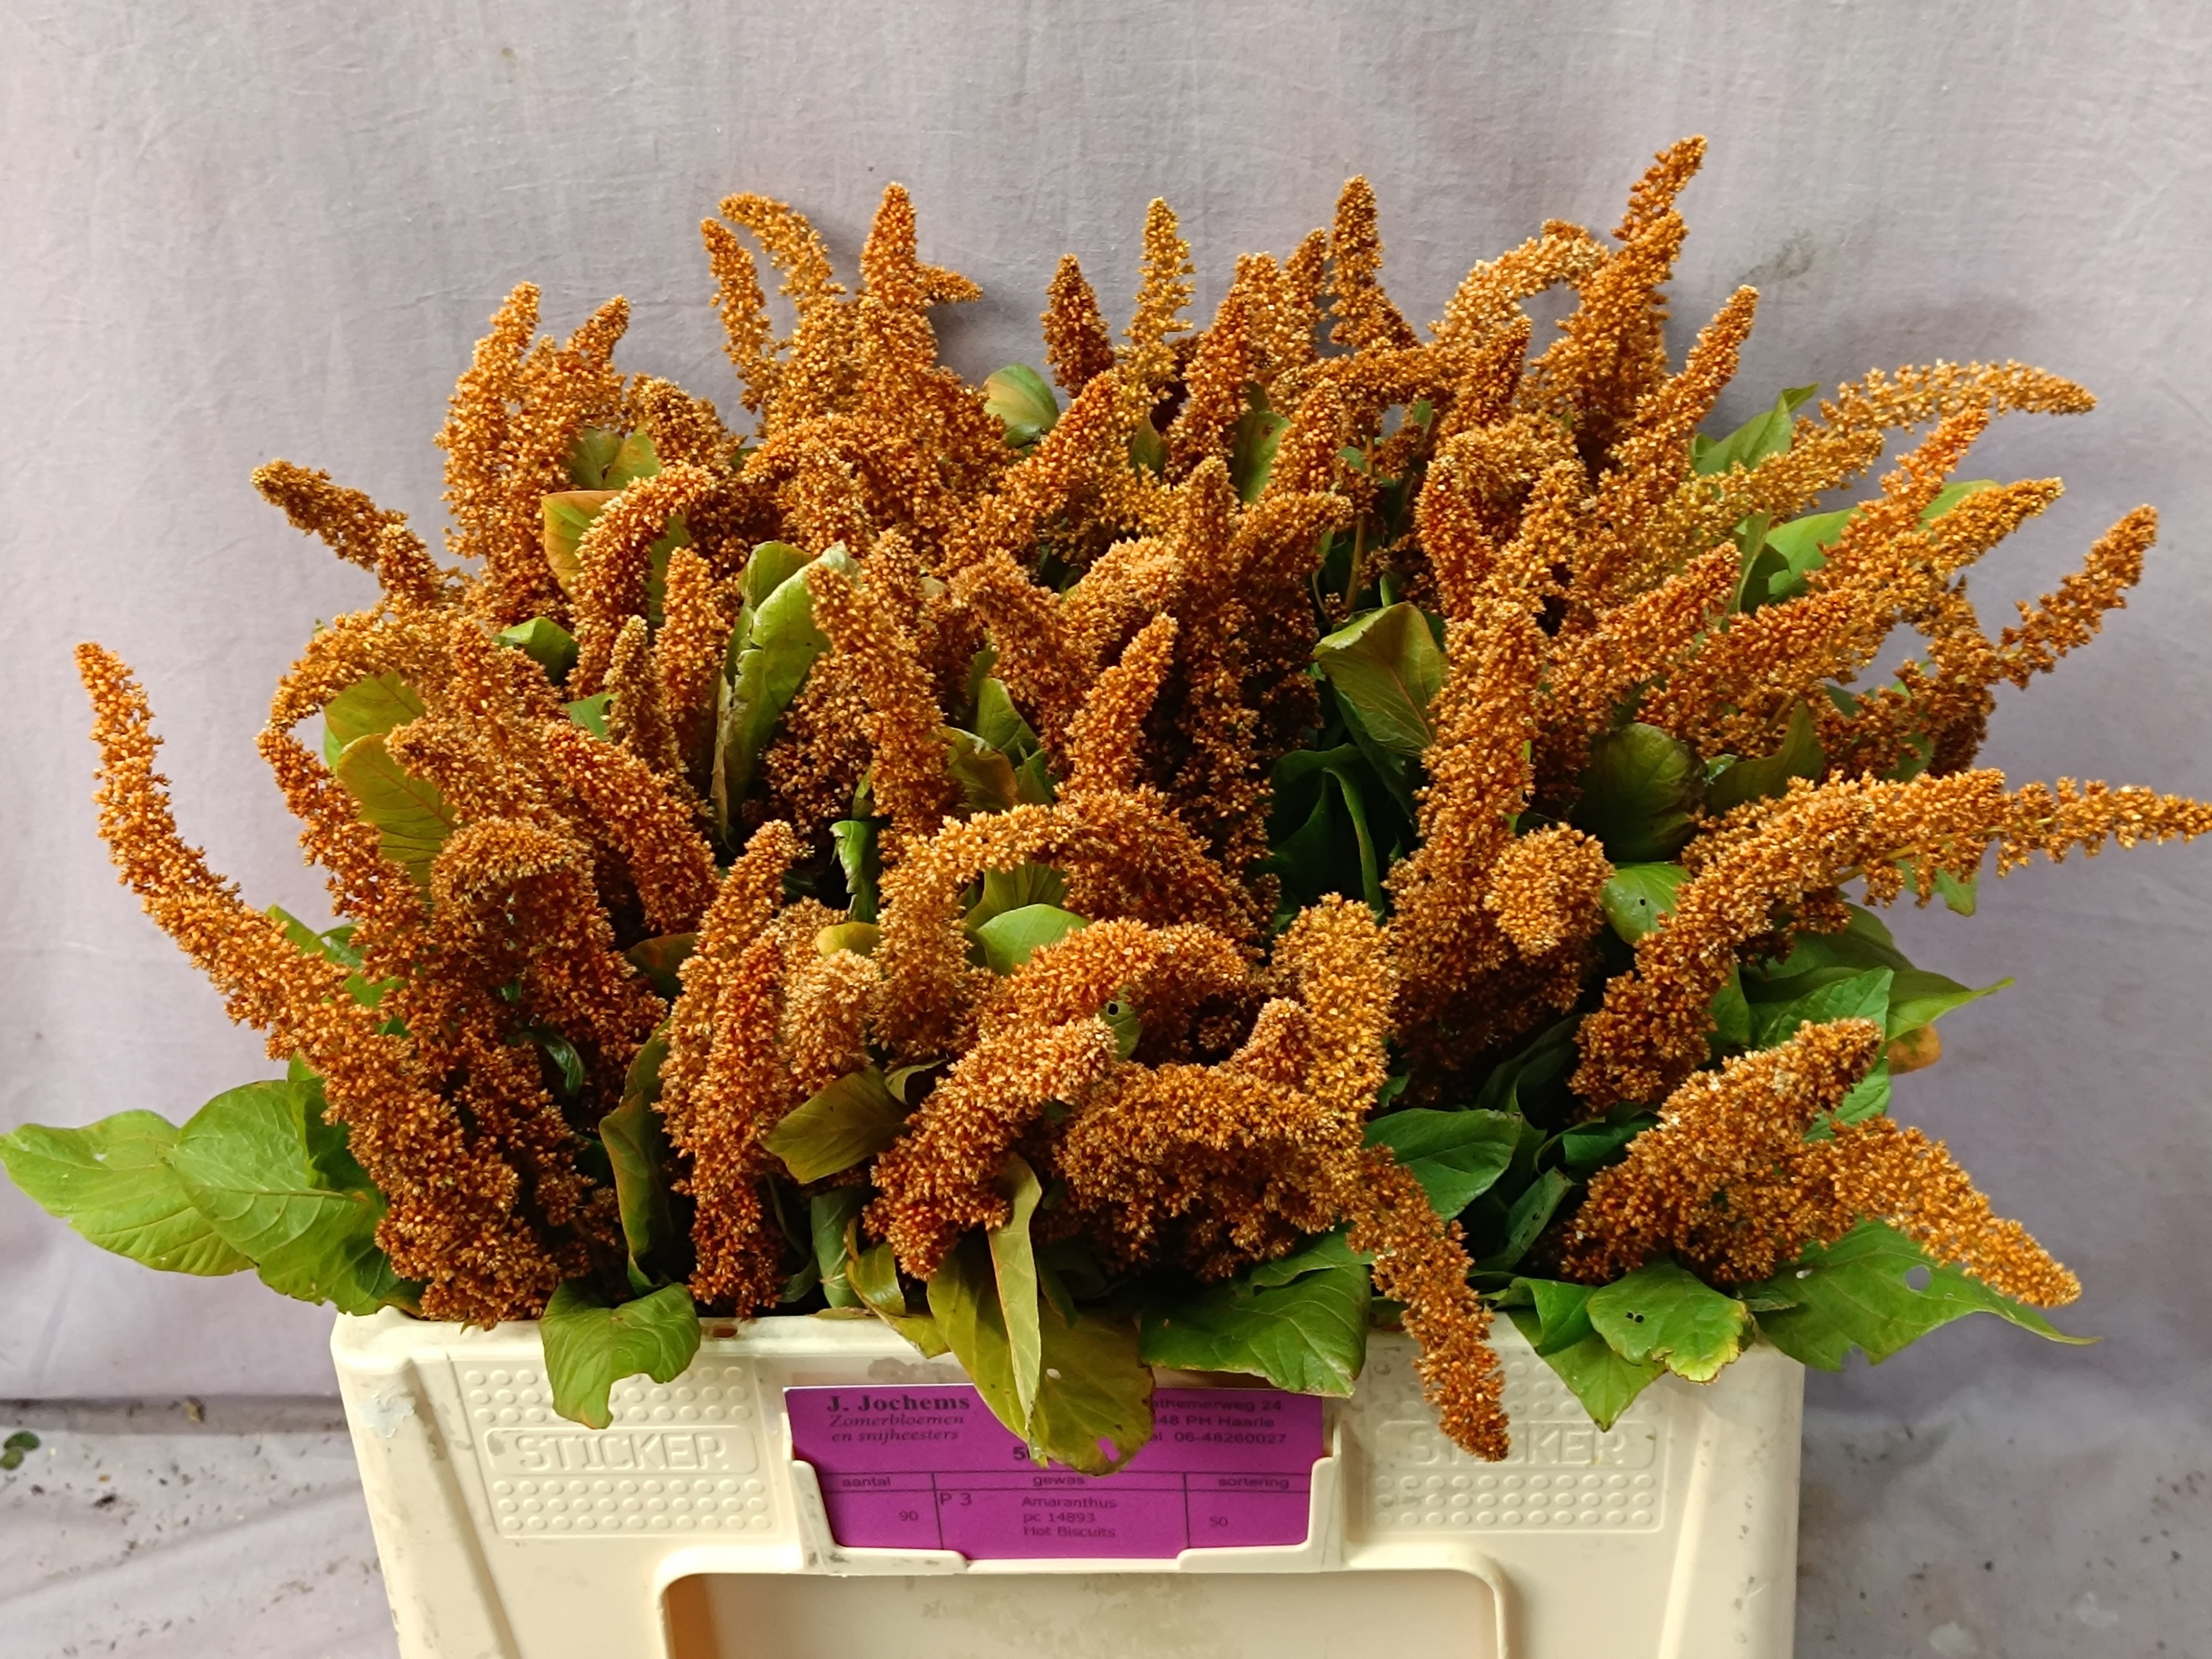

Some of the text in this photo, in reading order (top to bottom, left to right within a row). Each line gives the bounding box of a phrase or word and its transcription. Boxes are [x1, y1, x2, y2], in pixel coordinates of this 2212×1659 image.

[827, 1394, 970, 1411] J. Jochems
[1153, 1399, 1282, 1412] othemerweg 24
[830, 1413, 964, 1427] Zomerbloemen
[1152, 1415, 1275, 1427] 48 PH Haarle
[832, 1428, 959, 1444] en snijheesters
[515, 1433, 729, 1471] STICKER
[1408, 1426, 1626, 1465] STCKER
[842, 1477, 891, 1487] aantal
[1032, 1477, 1085, 1486] gewas
[1218, 1477, 1289, 1489] sortering
[940, 1493, 972, 1506] P 3
[1022, 1496, 1117, 1509] Amaranthus
[899, 1510, 919, 1521] 90
[1024, 1512, 1095, 1523] pc 14893
[1024, 1526, 1116, 1538] Hot Biscuits
